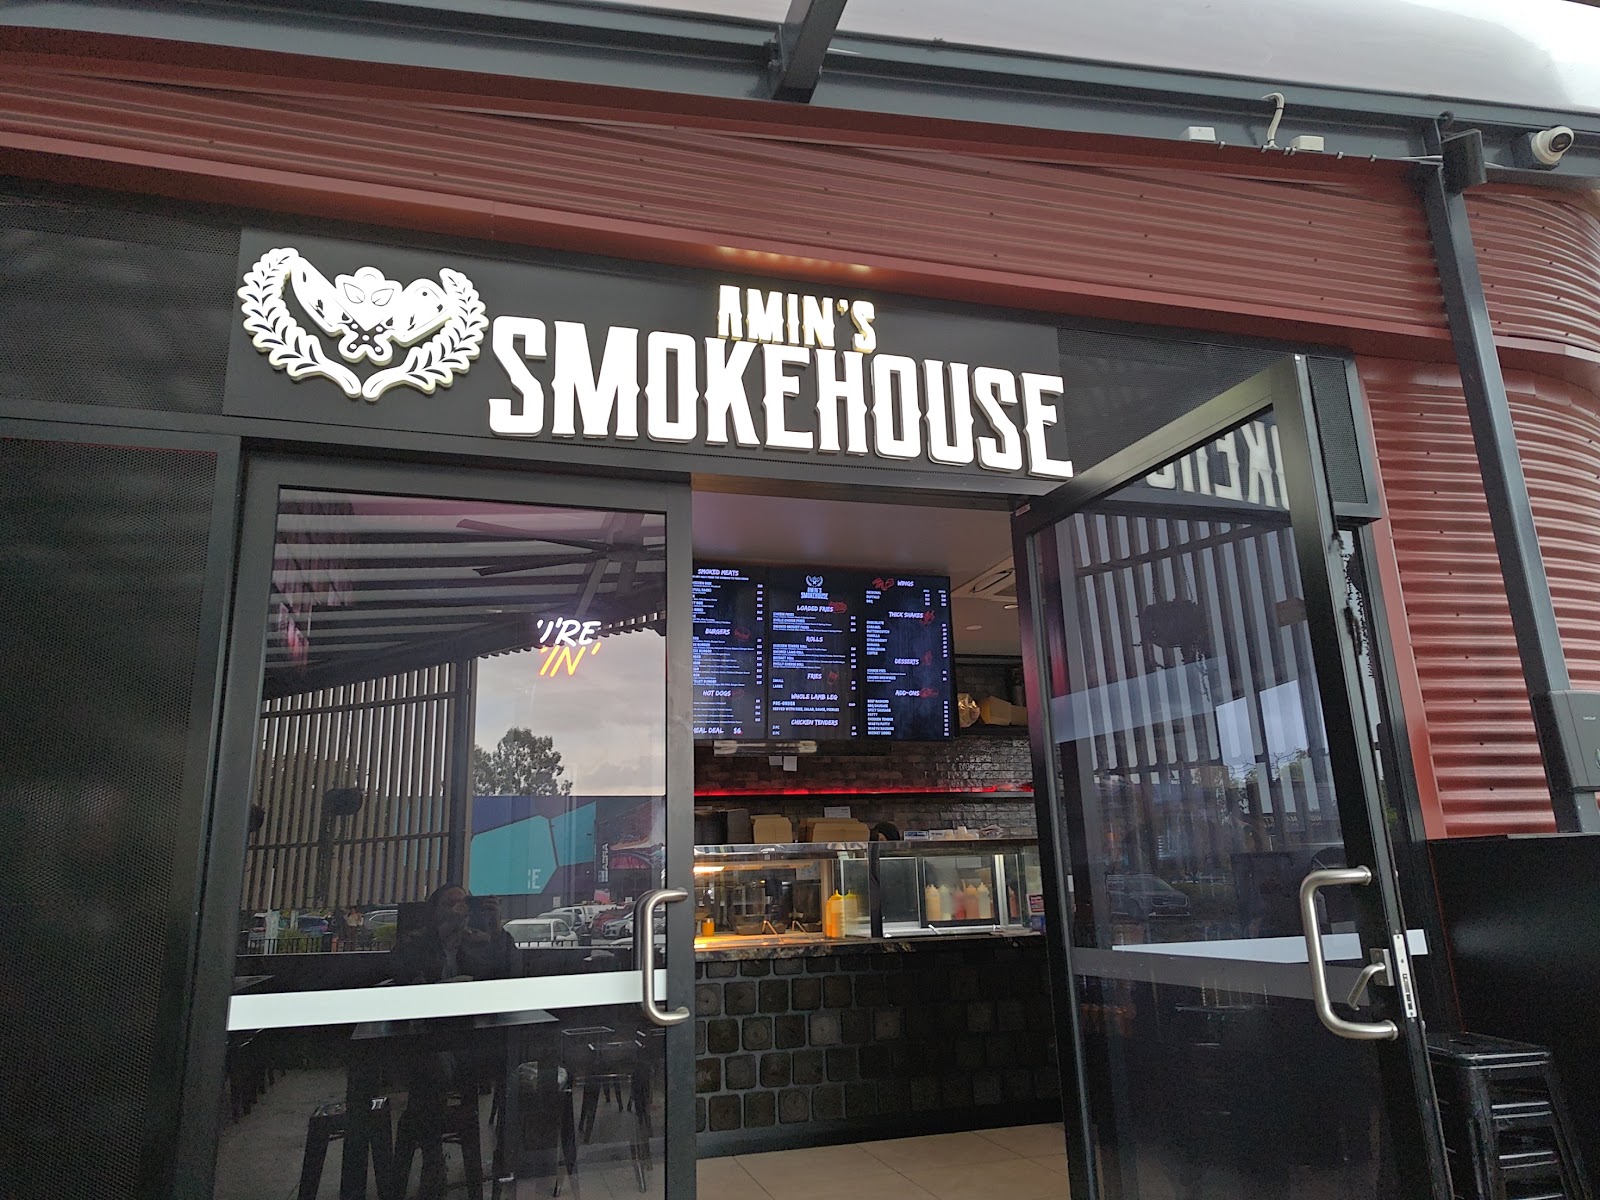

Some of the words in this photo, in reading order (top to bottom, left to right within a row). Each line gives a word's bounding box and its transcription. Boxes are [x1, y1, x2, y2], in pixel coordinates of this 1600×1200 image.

[717, 284, 876, 354] AMIN'S
[488, 314, 1075, 481] SMOKEHOUSE
[800, 592, 828, 600] SMOKEHOUSE
